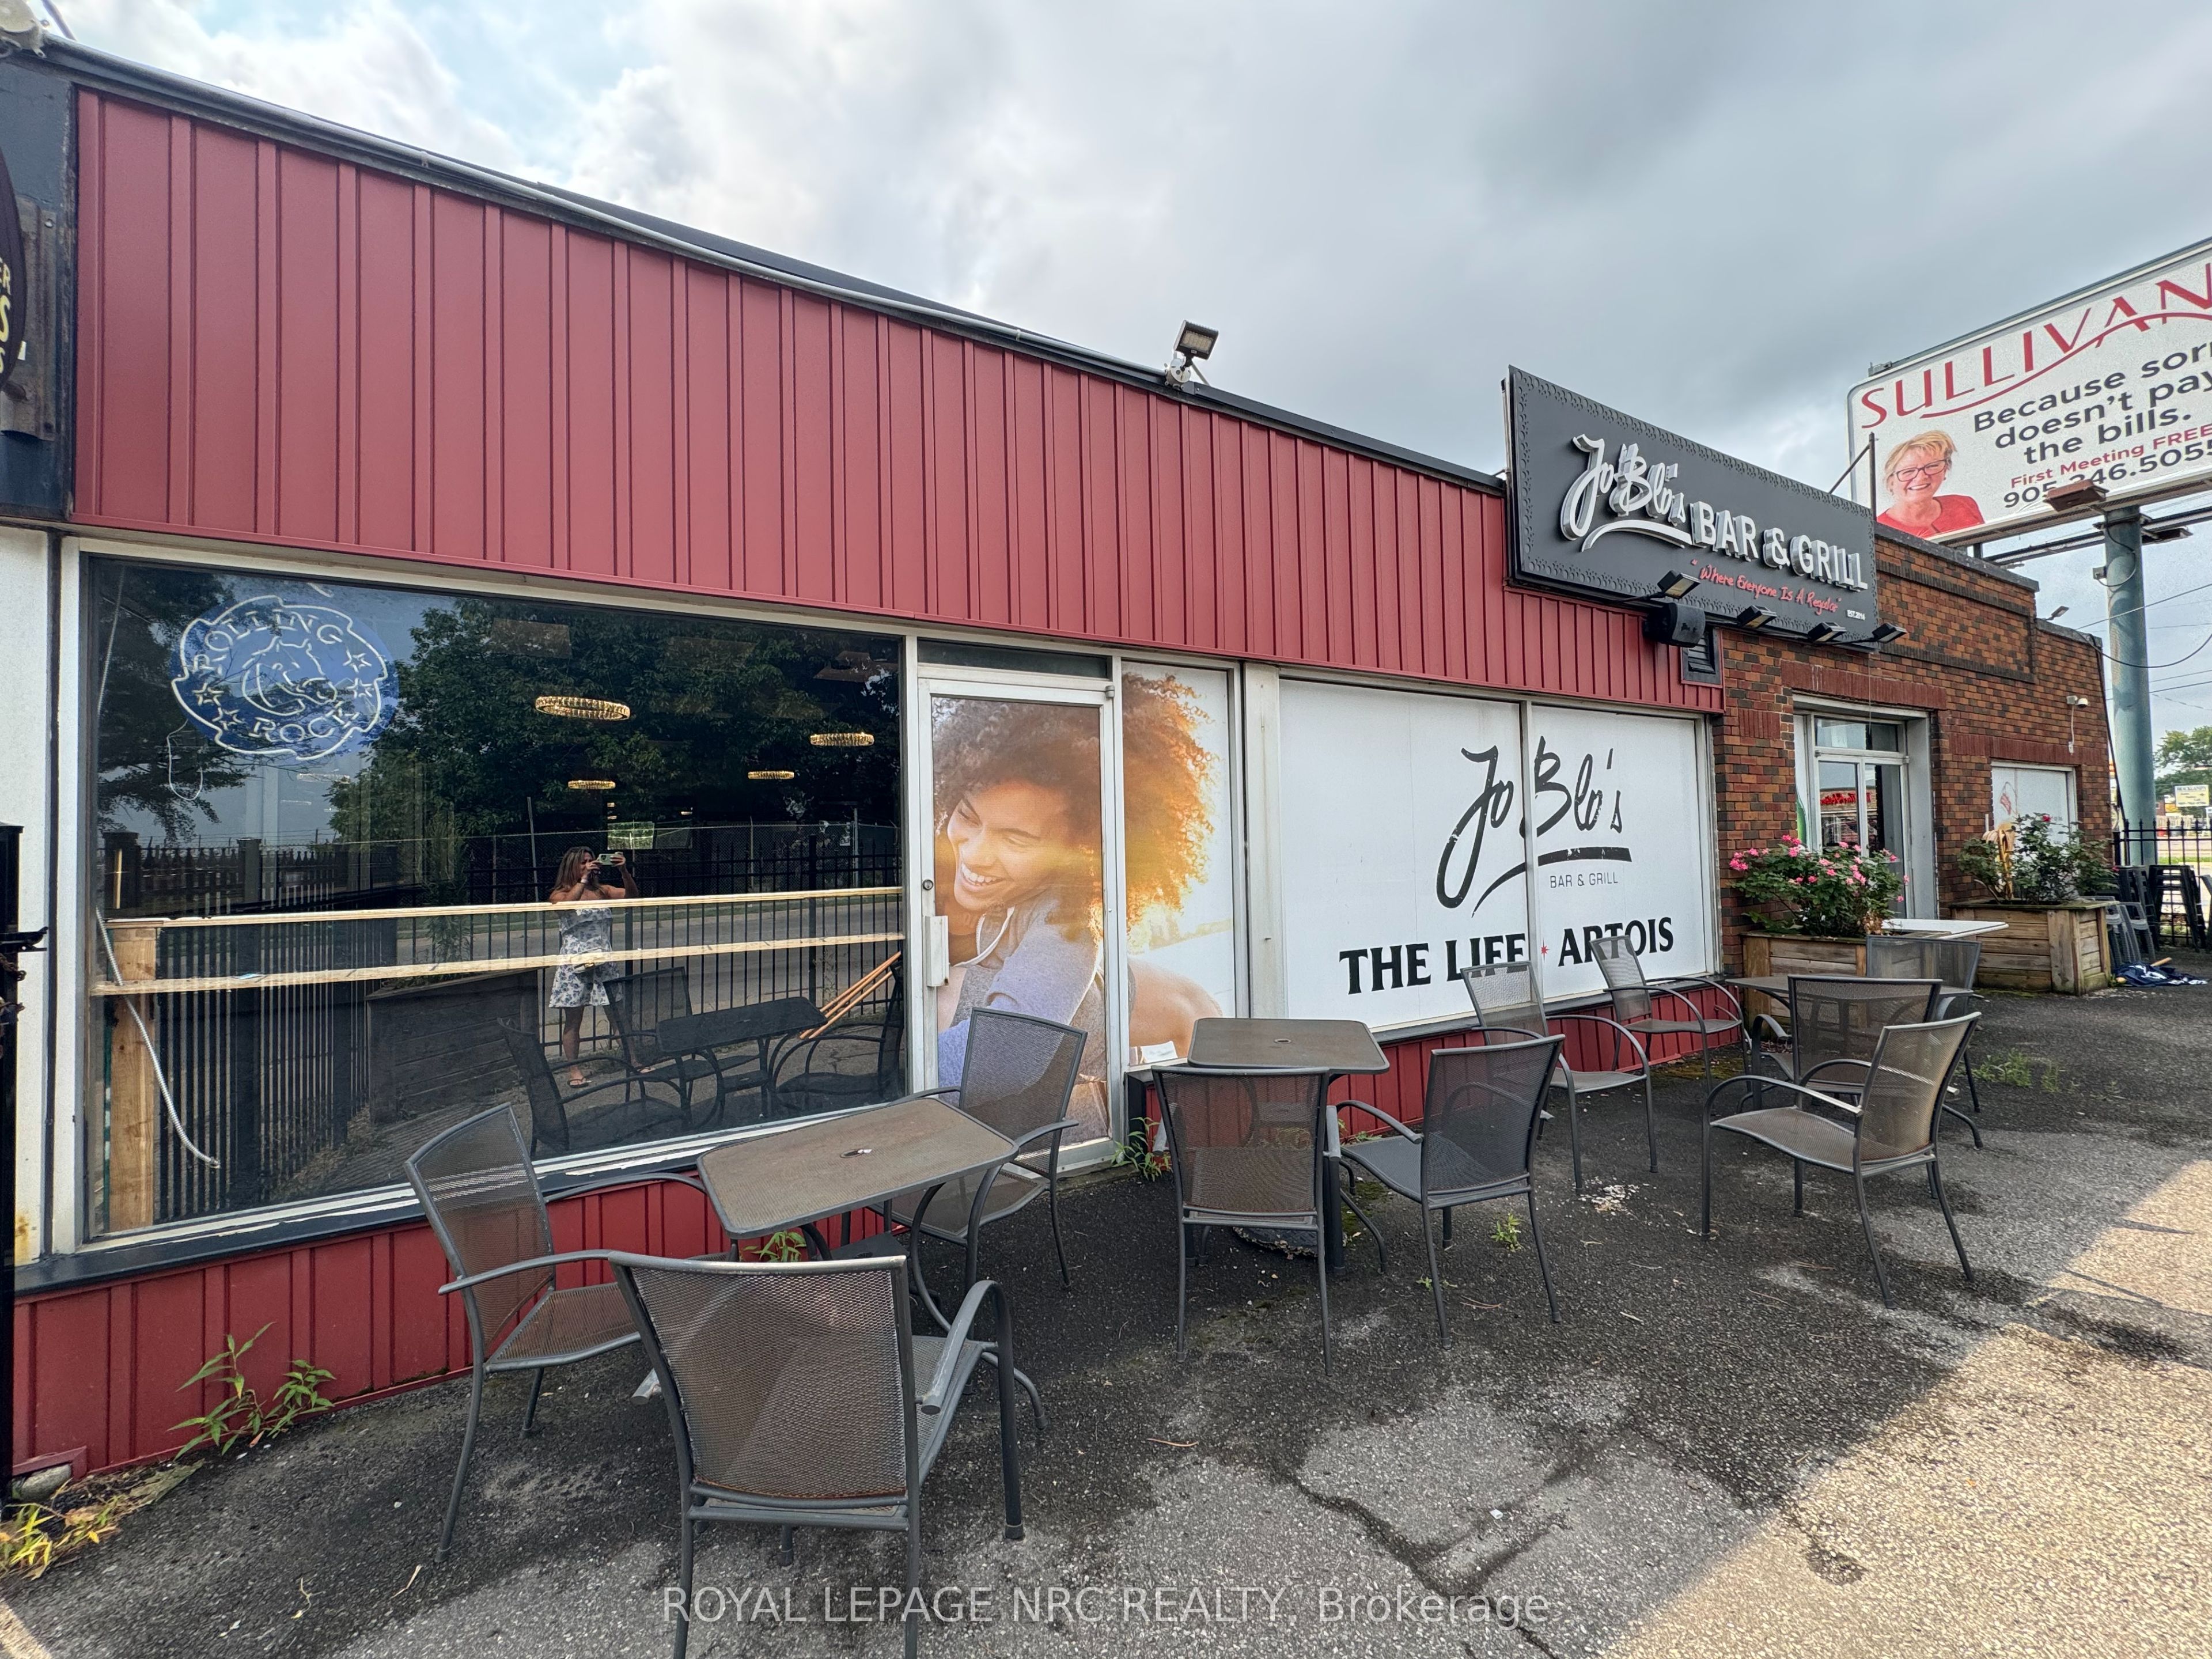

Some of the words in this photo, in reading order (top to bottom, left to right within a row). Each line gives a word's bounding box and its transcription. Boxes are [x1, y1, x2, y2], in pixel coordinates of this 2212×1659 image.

[1861, 263, 2212, 429] SULLIVAN
[1974, 371, 2126, 433] Because
[2141, 341, 2212, 378] sor
[1995, 391, 2133, 449] doesn't
[2024, 436, 2083, 464] the
[2098, 407, 2191, 445] bills.
[2011, 468, 2053, 488] First
[2060, 444, 2145, 475] Meeting
[2153, 423, 2212, 450] FREE
[1690, 501, 1759, 562] BAR
[1763, 528, 1790, 570] &
[1790, 535, 1868, 592] GRILL
[1737, 575, 1777, 599] Everyone
[1779, 586, 1793, 601] Is
[1796, 587, 1804, 604] A
[192, 609, 344, 676] ROLLING
[248, 701, 359, 743] ROCK
[1550, 874, 1573, 888] BAR
[1577, 874, 1585, 886] &
[1589, 872, 1619, 885] GRILL
[1339, 943, 1431, 994] THE
[1445, 933, 1527, 982] LIFE
[1558, 917, 1674, 967] ARTOIS
